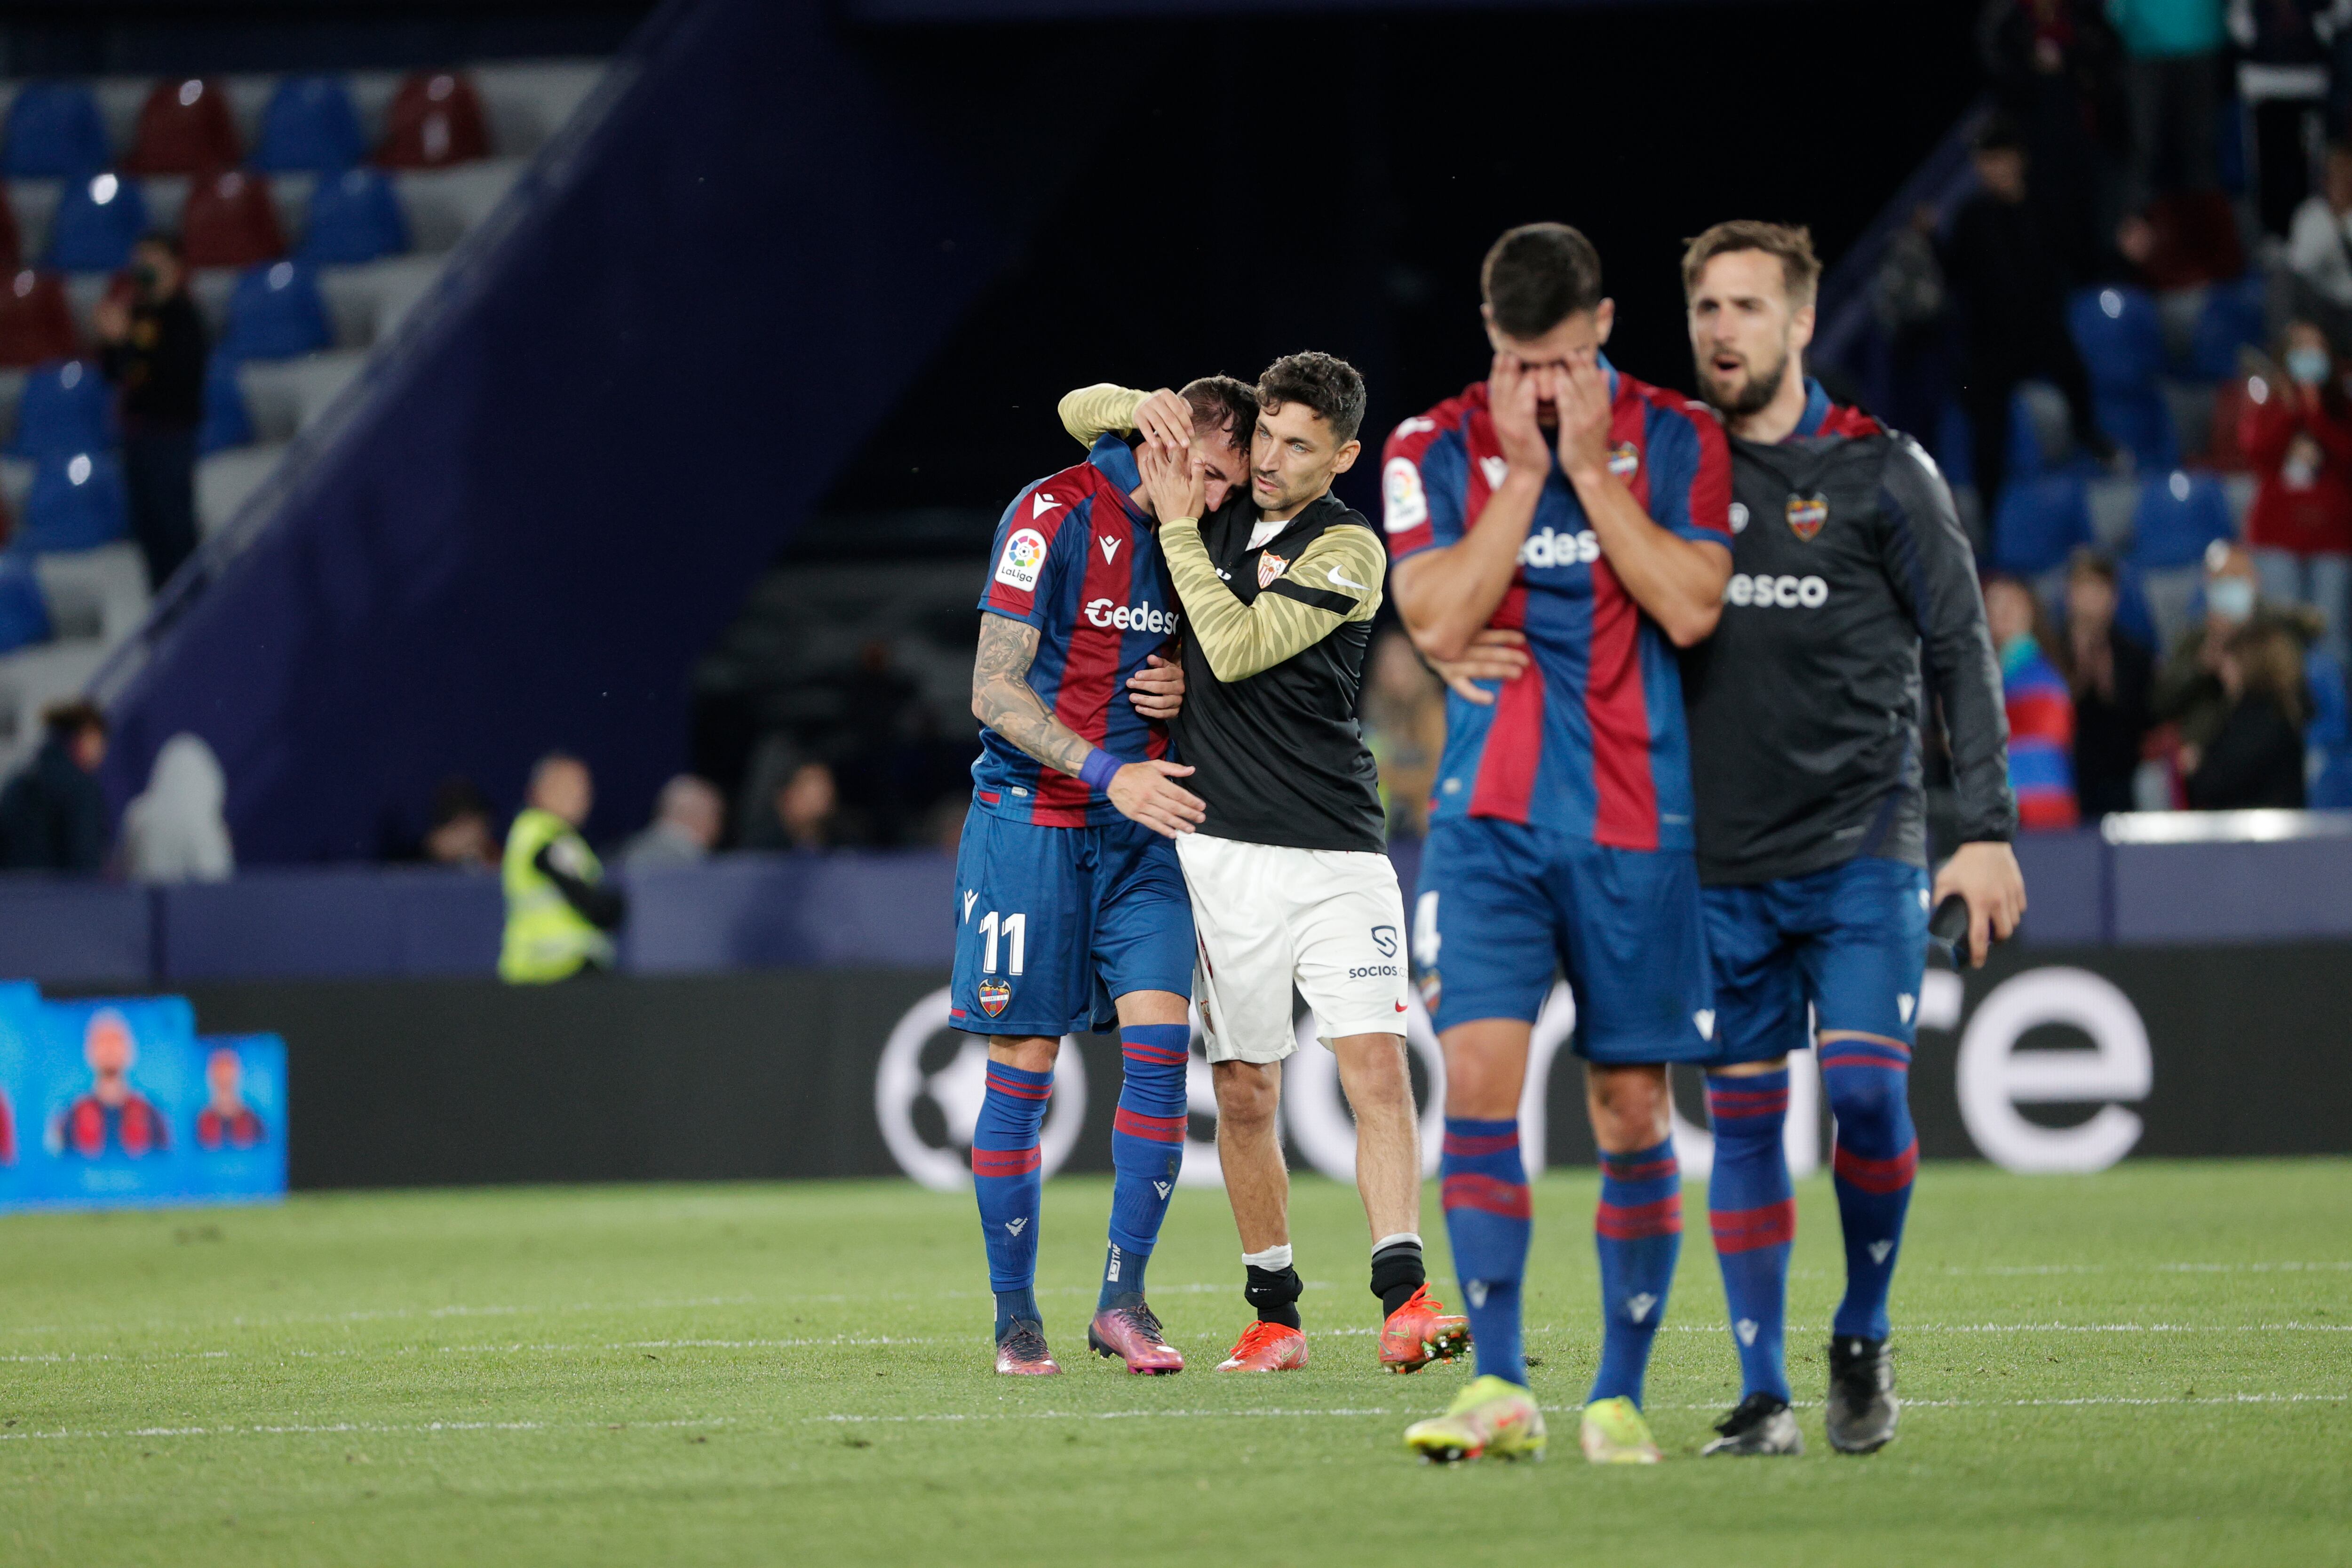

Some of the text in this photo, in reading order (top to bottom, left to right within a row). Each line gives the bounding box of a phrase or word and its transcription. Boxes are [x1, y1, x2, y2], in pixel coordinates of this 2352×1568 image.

[1001, 566, 1033, 582] LaLiga
[1722, 573, 1828, 609] esco
[979, 911, 1025, 976] 11
